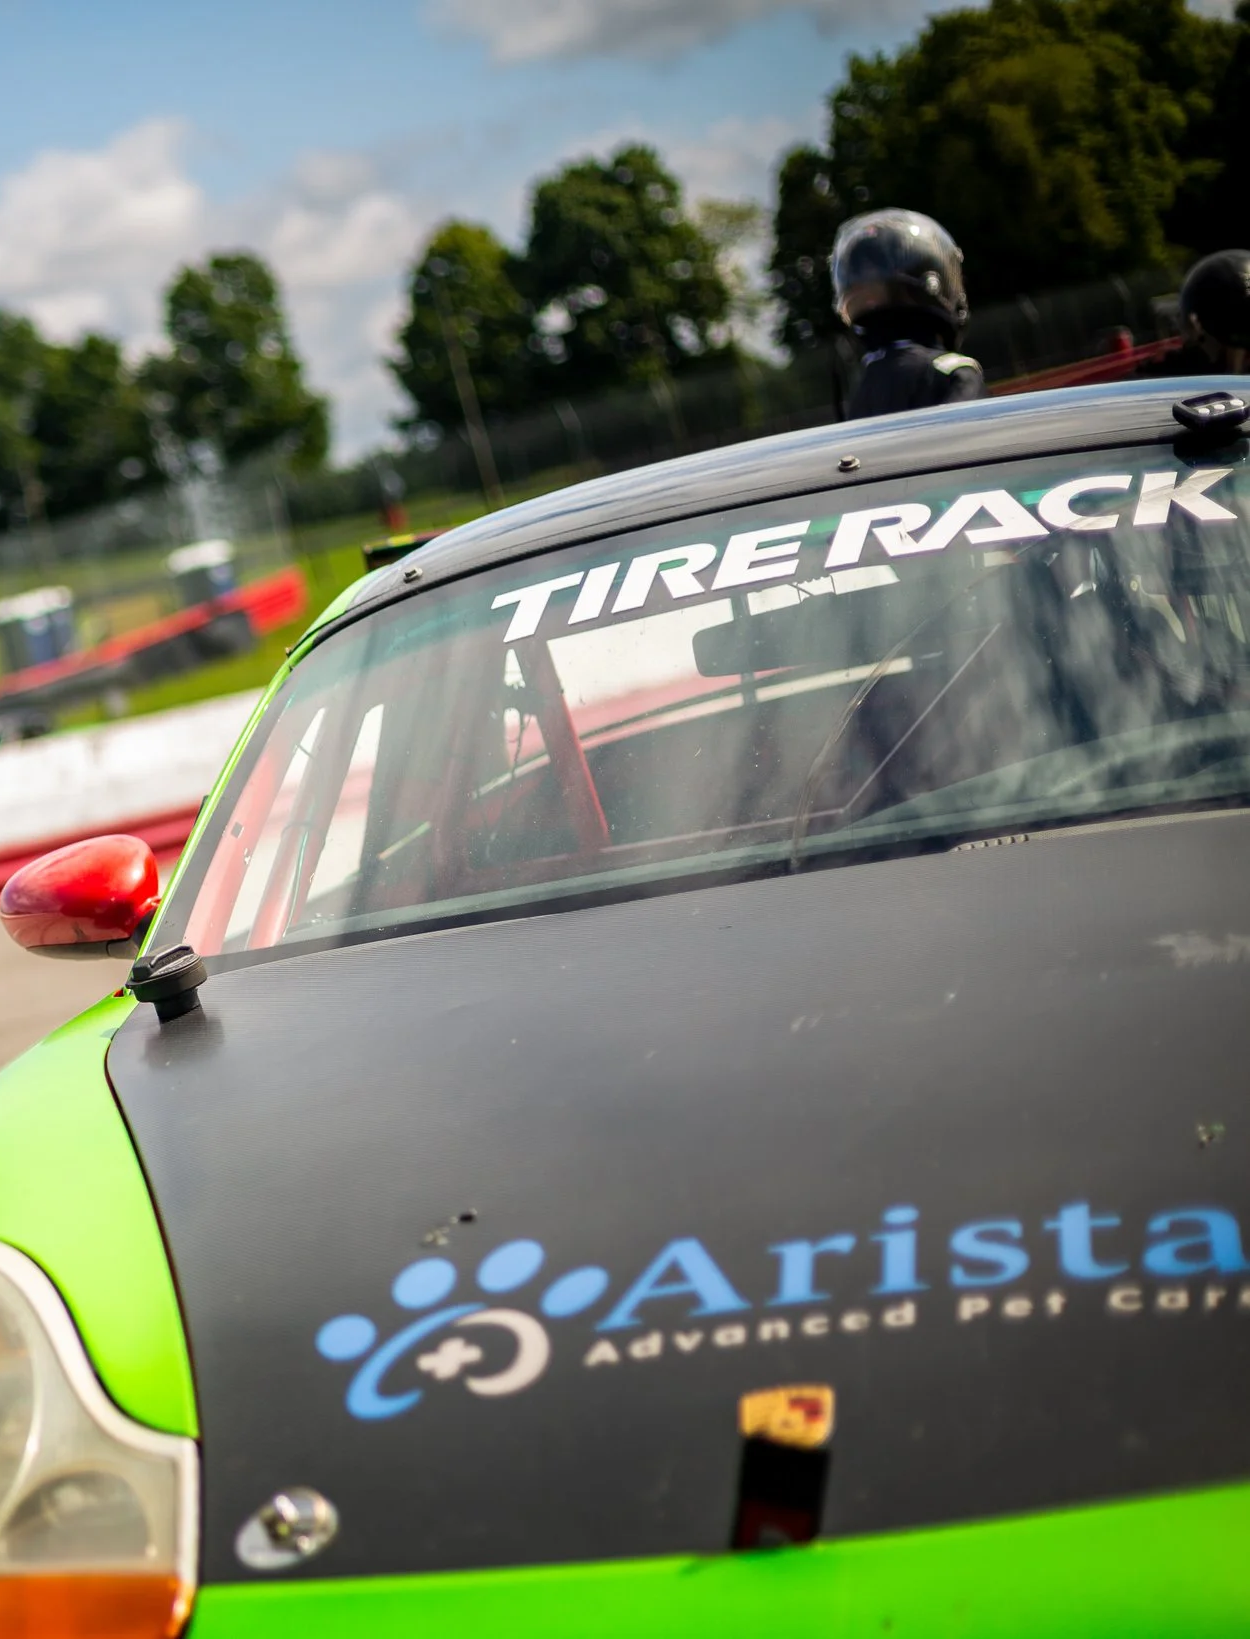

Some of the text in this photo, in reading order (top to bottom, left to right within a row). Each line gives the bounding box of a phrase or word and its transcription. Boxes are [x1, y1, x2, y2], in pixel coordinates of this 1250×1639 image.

[490, 468, 1238, 643] TIRE RACK
[584, 1298, 917, 1367] Advanced
[957, 1291, 1066, 1322] Pet
[594, 1198, 1250, 1332] Arista
